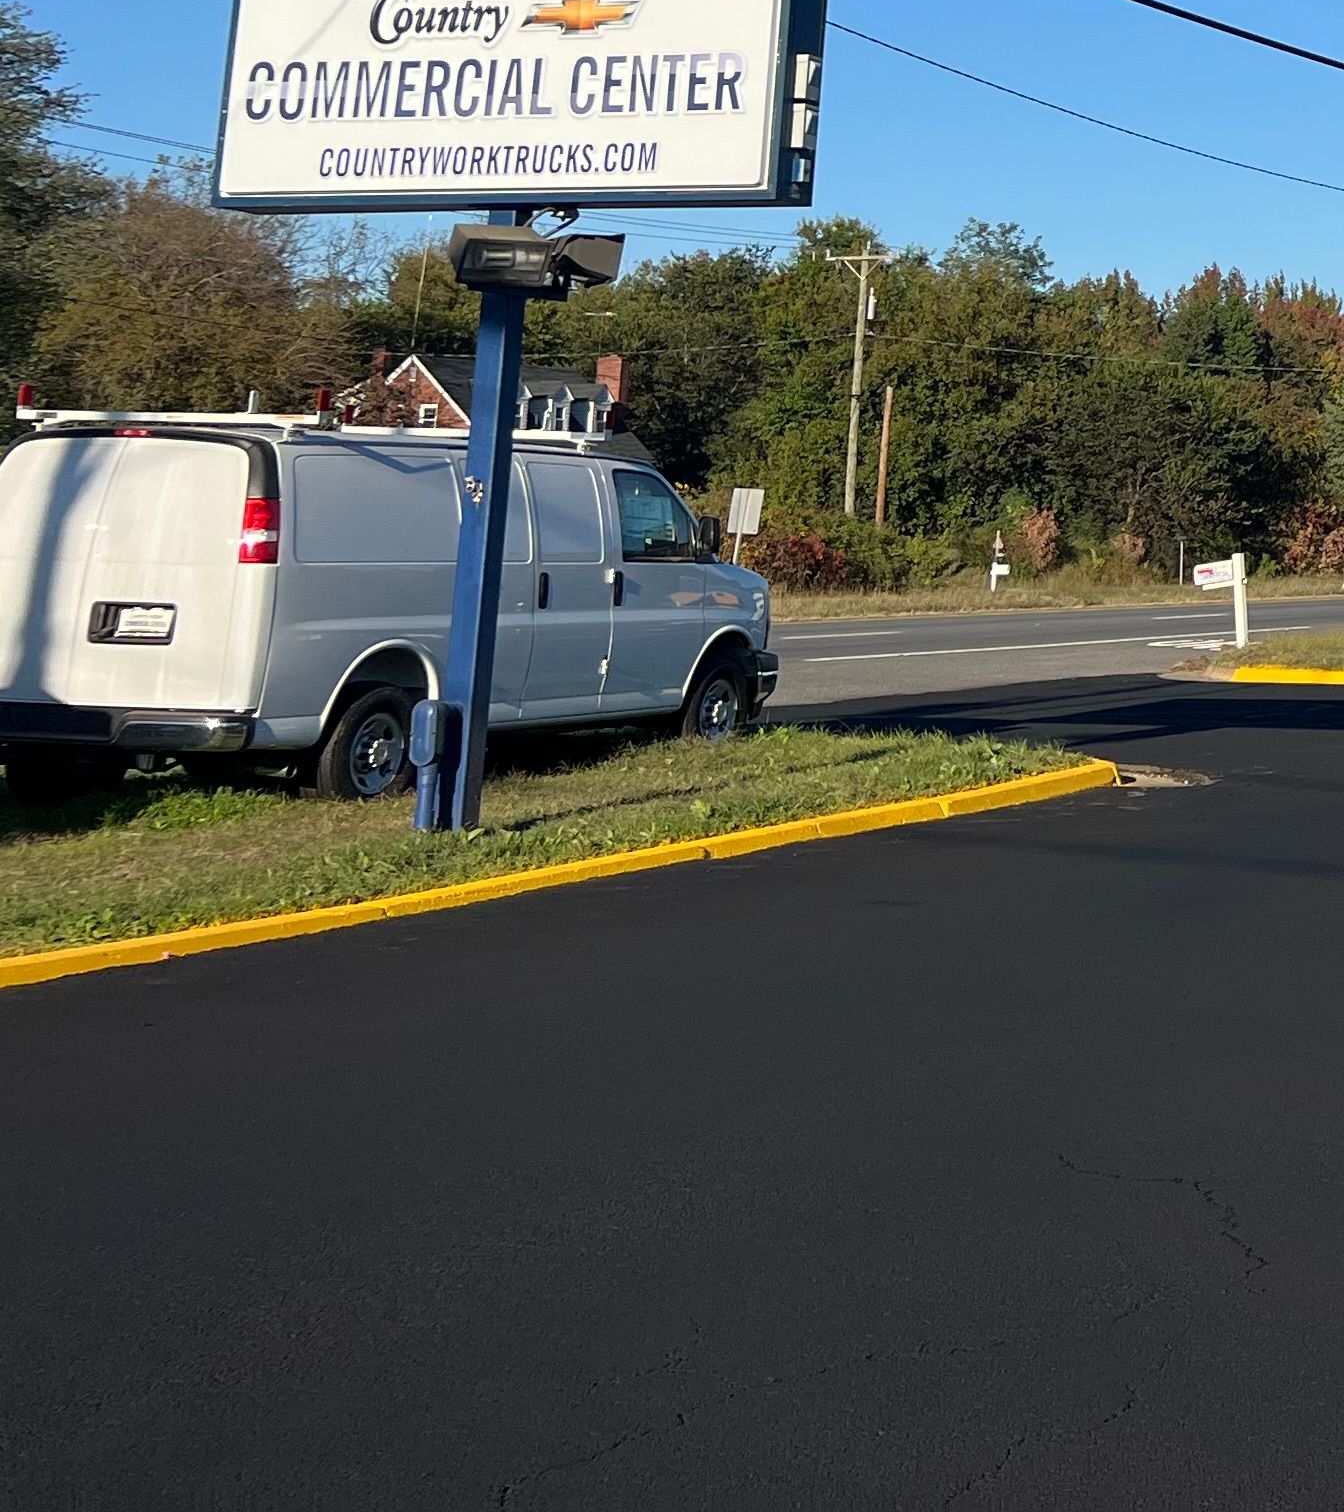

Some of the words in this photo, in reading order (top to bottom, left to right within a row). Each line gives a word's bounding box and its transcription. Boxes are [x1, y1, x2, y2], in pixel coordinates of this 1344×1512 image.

[245, 57, 552, 122] COMMERCIAL
[570, 52, 744, 114] CENTER
[319, 142, 658, 178] COUNTRYWORKTRUCKS.COM
